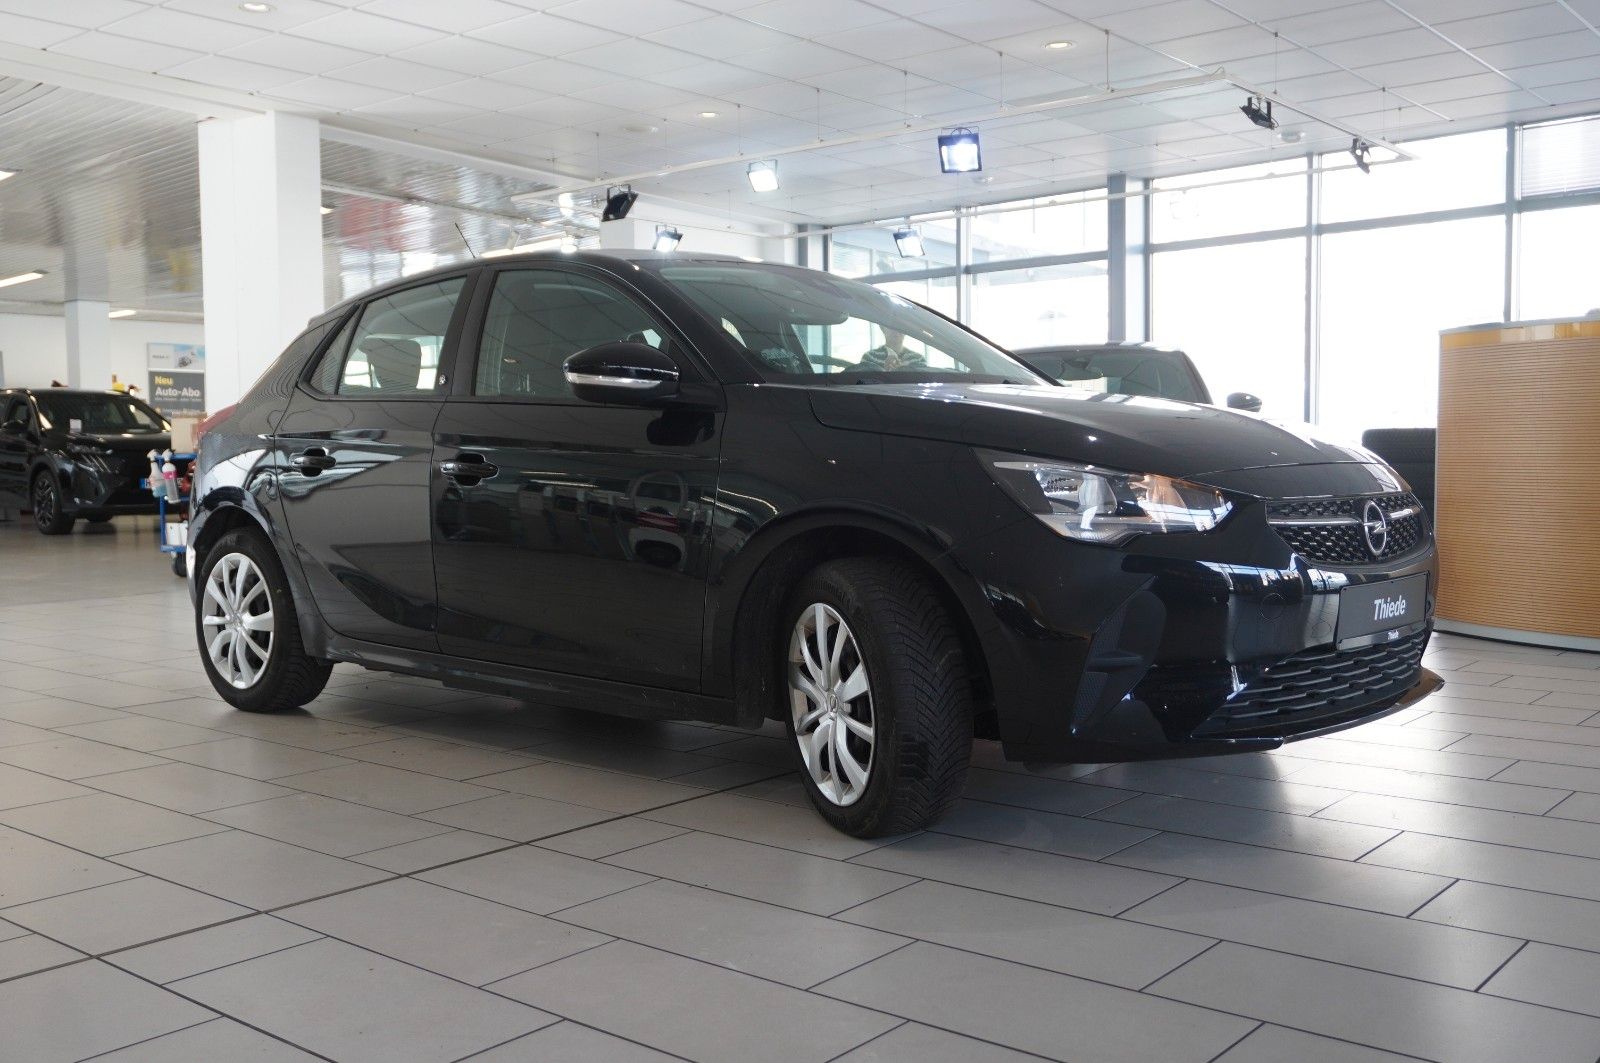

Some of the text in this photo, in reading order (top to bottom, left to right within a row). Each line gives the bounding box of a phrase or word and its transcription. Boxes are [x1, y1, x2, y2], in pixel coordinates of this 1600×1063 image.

[154, 376, 173, 386] Neu
[155, 387, 200, 397] Auto-Abo
[1374, 595, 1406, 620] Thiede
